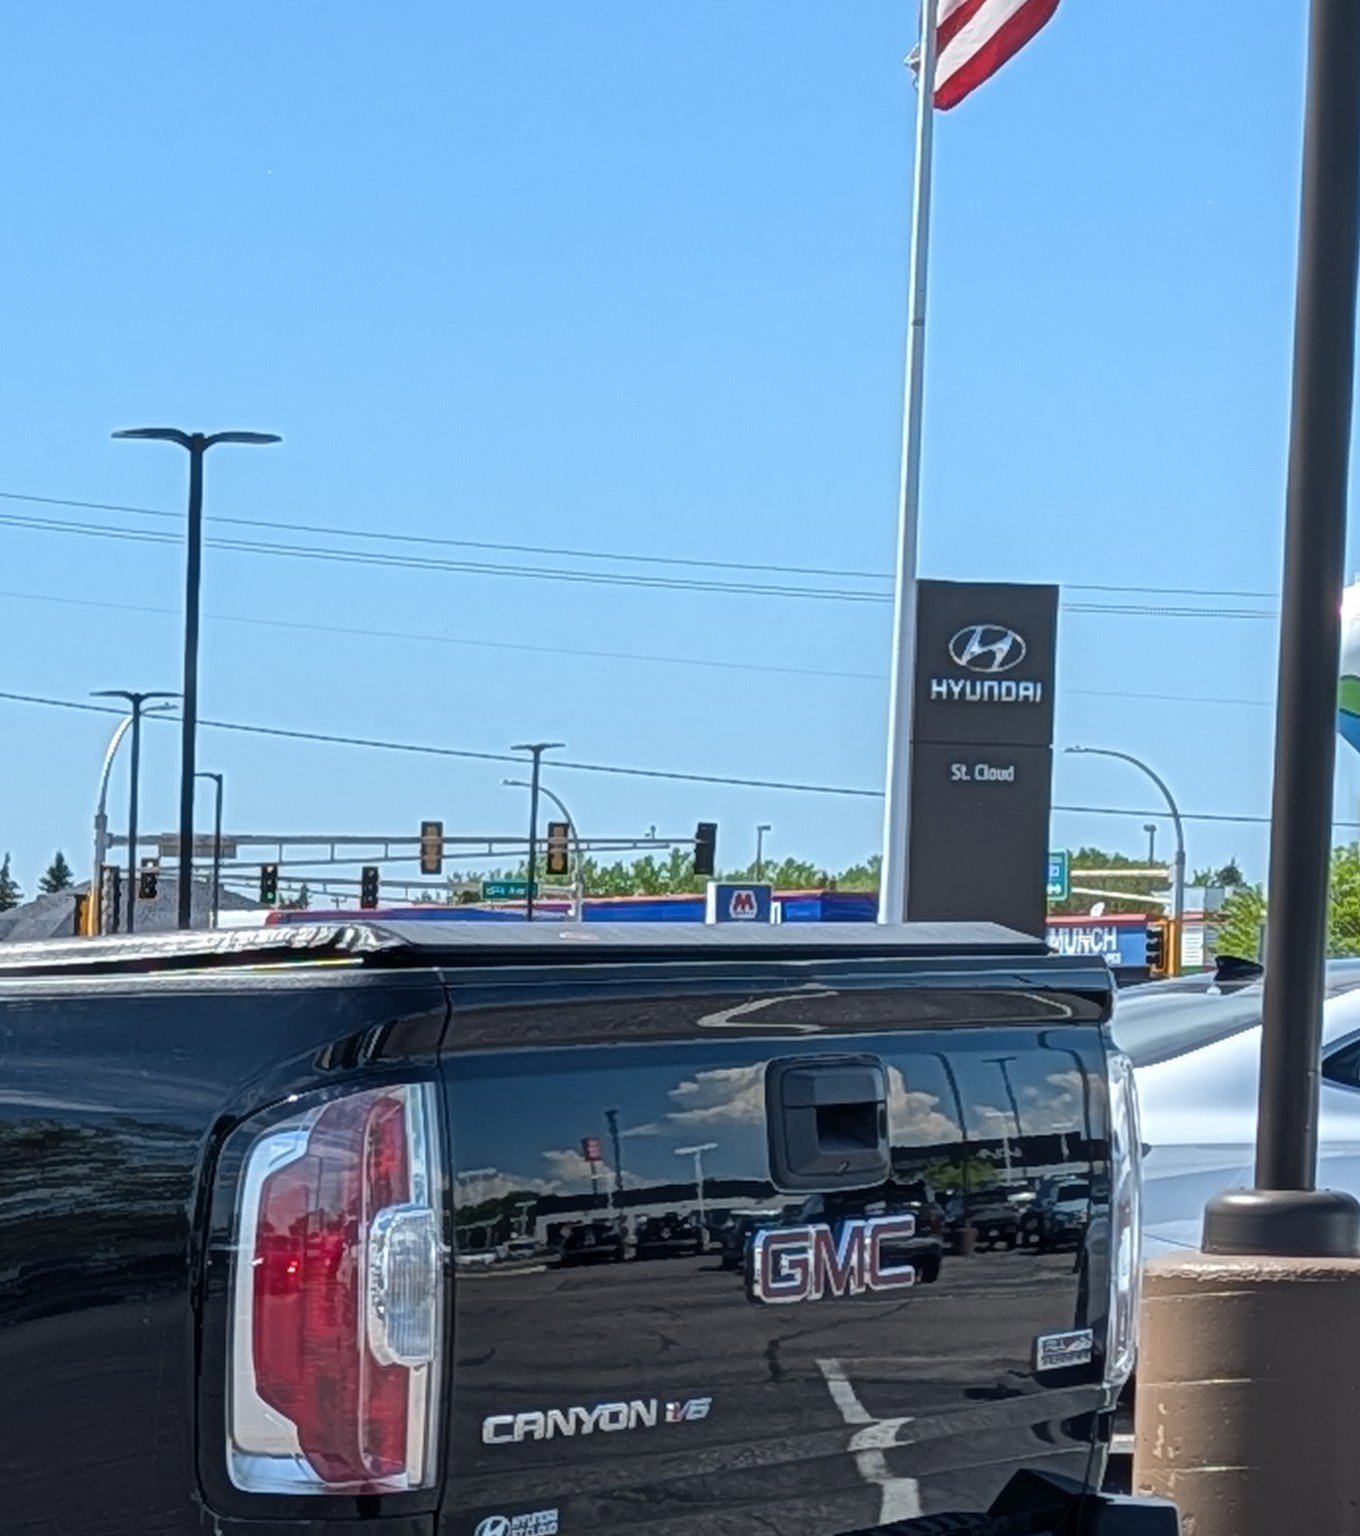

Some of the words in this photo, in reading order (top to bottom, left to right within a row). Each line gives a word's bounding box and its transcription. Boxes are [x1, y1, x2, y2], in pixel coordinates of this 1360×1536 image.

[930, 678, 1041, 702] HYUNDAI
[974, 764, 1015, 781] Cloud
[753, 1214, 916, 1304] GMC
[482, 1398, 658, 1445] CANYON
